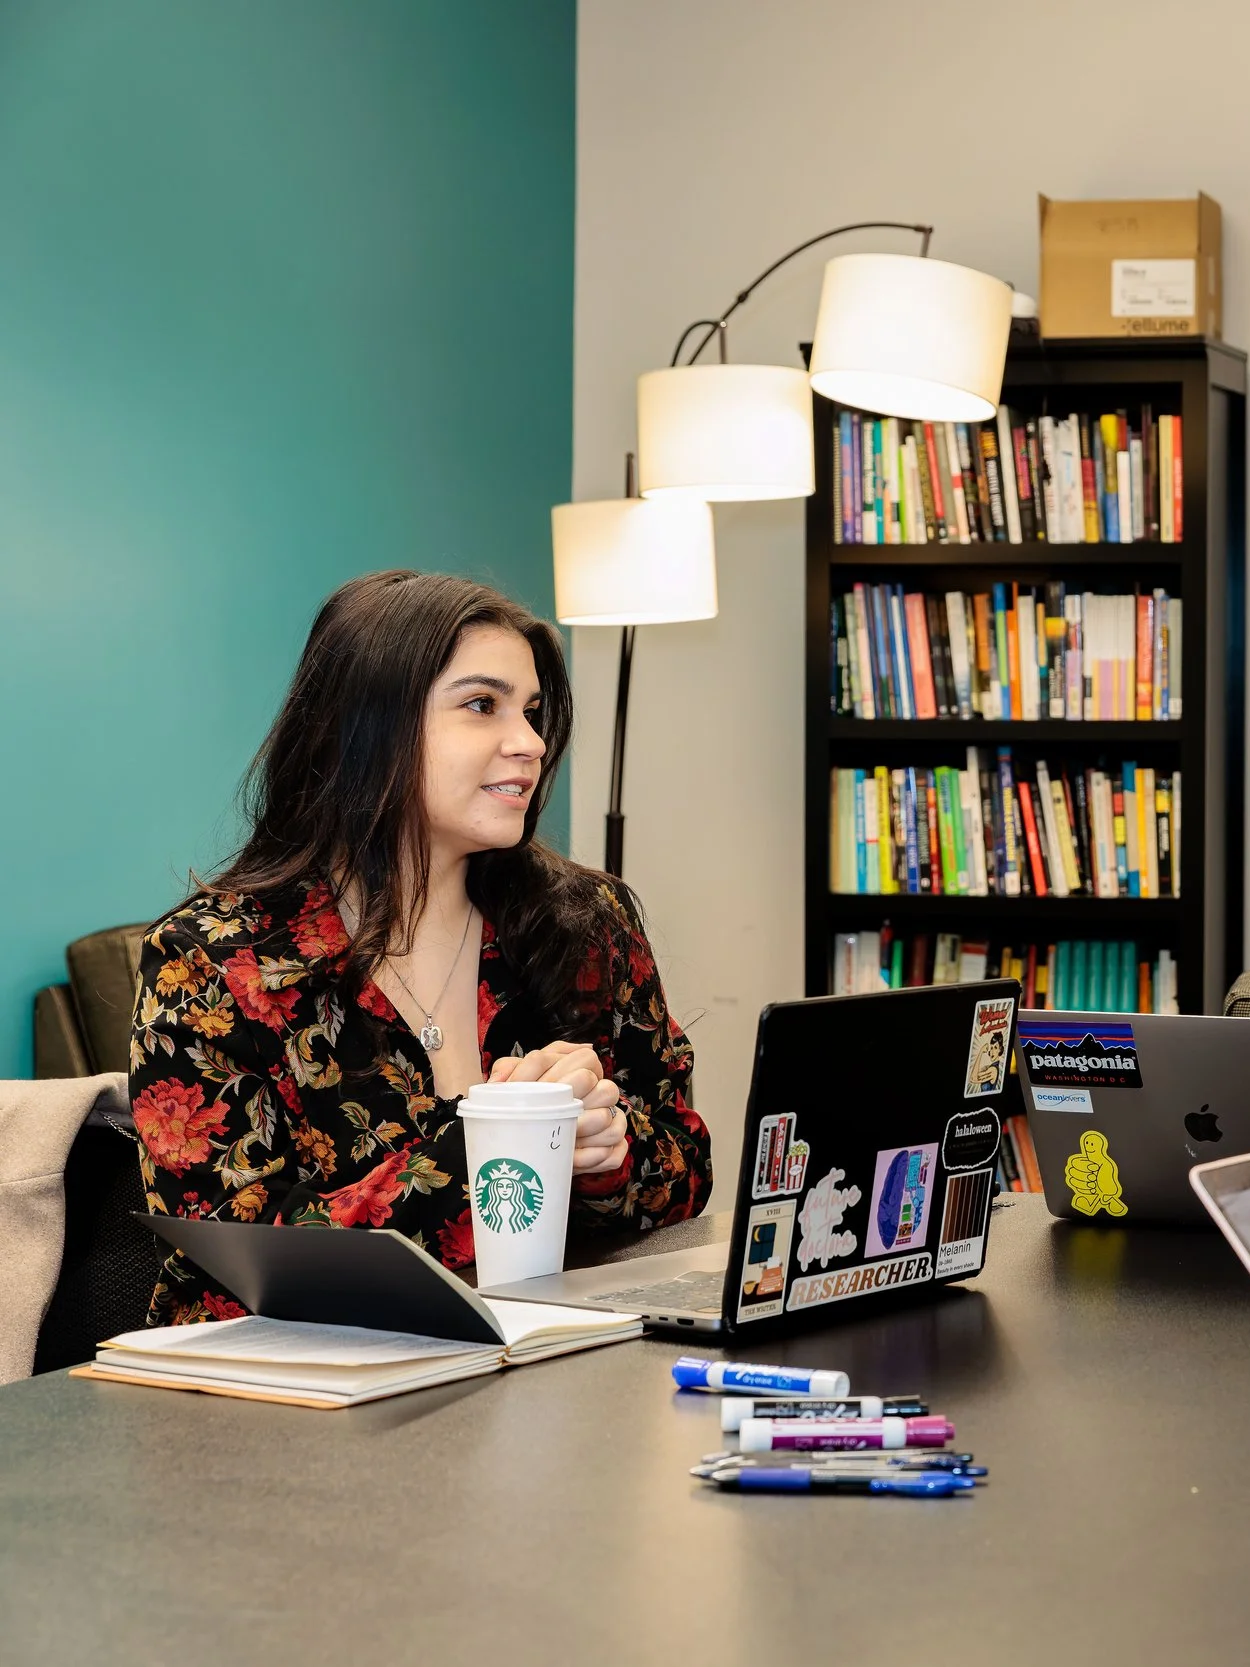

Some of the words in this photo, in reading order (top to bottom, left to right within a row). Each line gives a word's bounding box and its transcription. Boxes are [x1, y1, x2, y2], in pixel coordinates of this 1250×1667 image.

[1029, 1053, 1137, 1072] patagonia
[1044, 1074, 1106, 1083] WASHINGTON
[1036, 1093, 1086, 1103] oceanlovers
[939, 1240, 971, 1258] Melanin
[788, 1256, 932, 1307] RESEARCHER.
